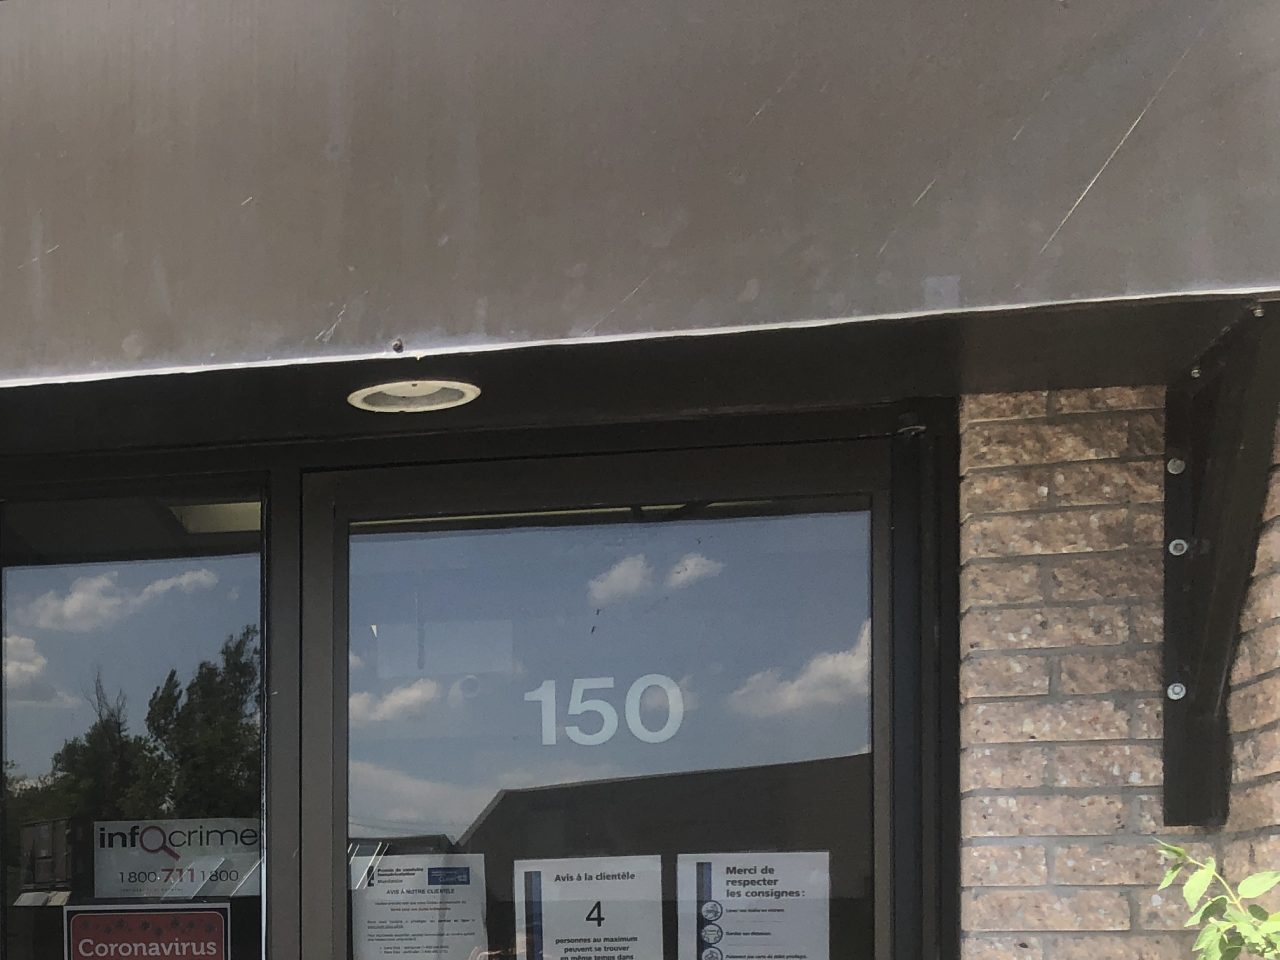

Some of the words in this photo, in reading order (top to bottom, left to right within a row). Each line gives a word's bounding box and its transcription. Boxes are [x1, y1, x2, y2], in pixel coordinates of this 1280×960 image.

[524, 673, 684, 746] 150
[726, 865, 757, 875] Merci
[760, 865, 775, 875] de
[554, 873, 574, 882] Avis
[576, 873, 582, 881] à
[584, 872, 593, 881] la
[595, 871, 636, 881] clientèle
[726, 878, 779, 887] respecter
[726, 889, 742, 898] les
[585, 900, 605, 927] 4
[555, 937, 591, 945] personnes
[78, 938, 217, 957] Coronavirus
[617, 953, 634, 960] dans
